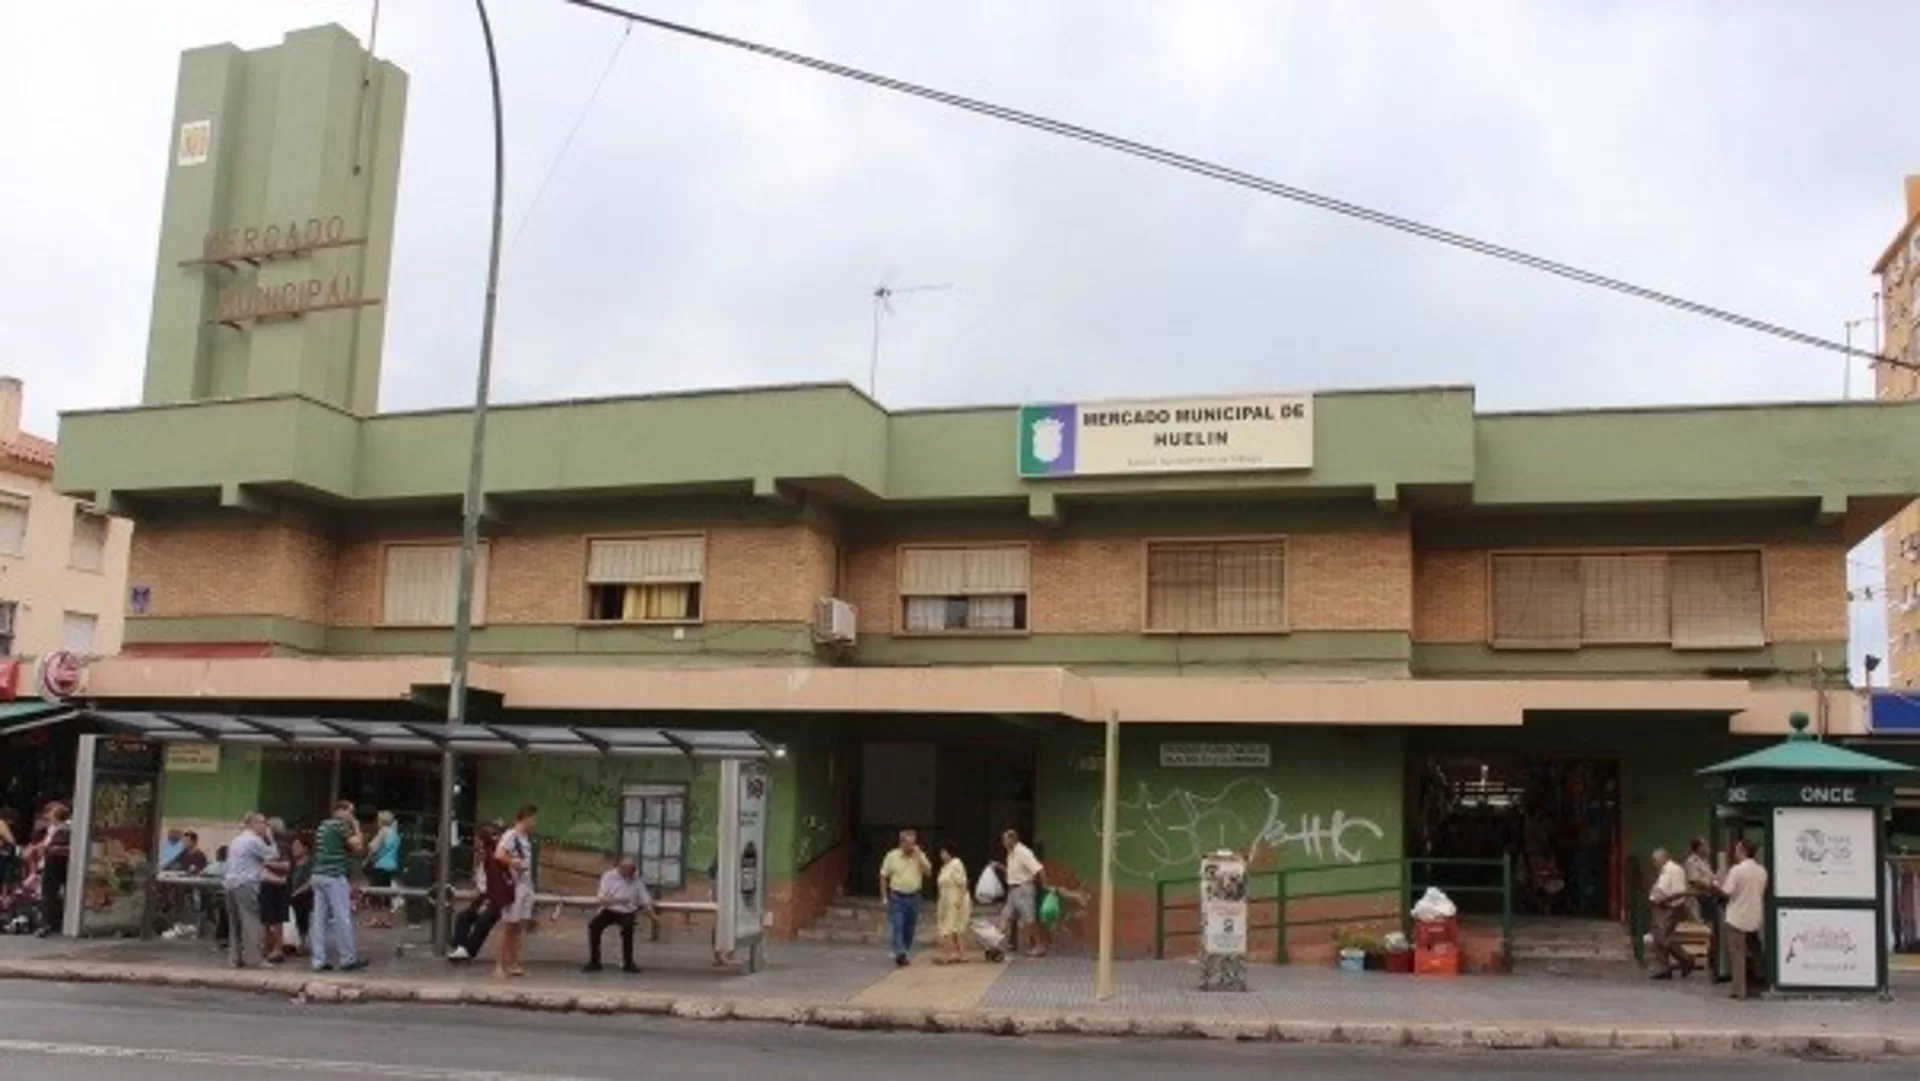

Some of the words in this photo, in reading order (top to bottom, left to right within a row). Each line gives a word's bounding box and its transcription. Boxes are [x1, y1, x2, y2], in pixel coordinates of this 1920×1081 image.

[1083, 409, 1171, 426] MERCADO
[1175, 406, 1275, 423] MUNICIPAL
[1280, 403, 1305, 419] DE
[1153, 431, 1229, 446] HUELIN
[1800, 786, 1857, 802] ONCE
